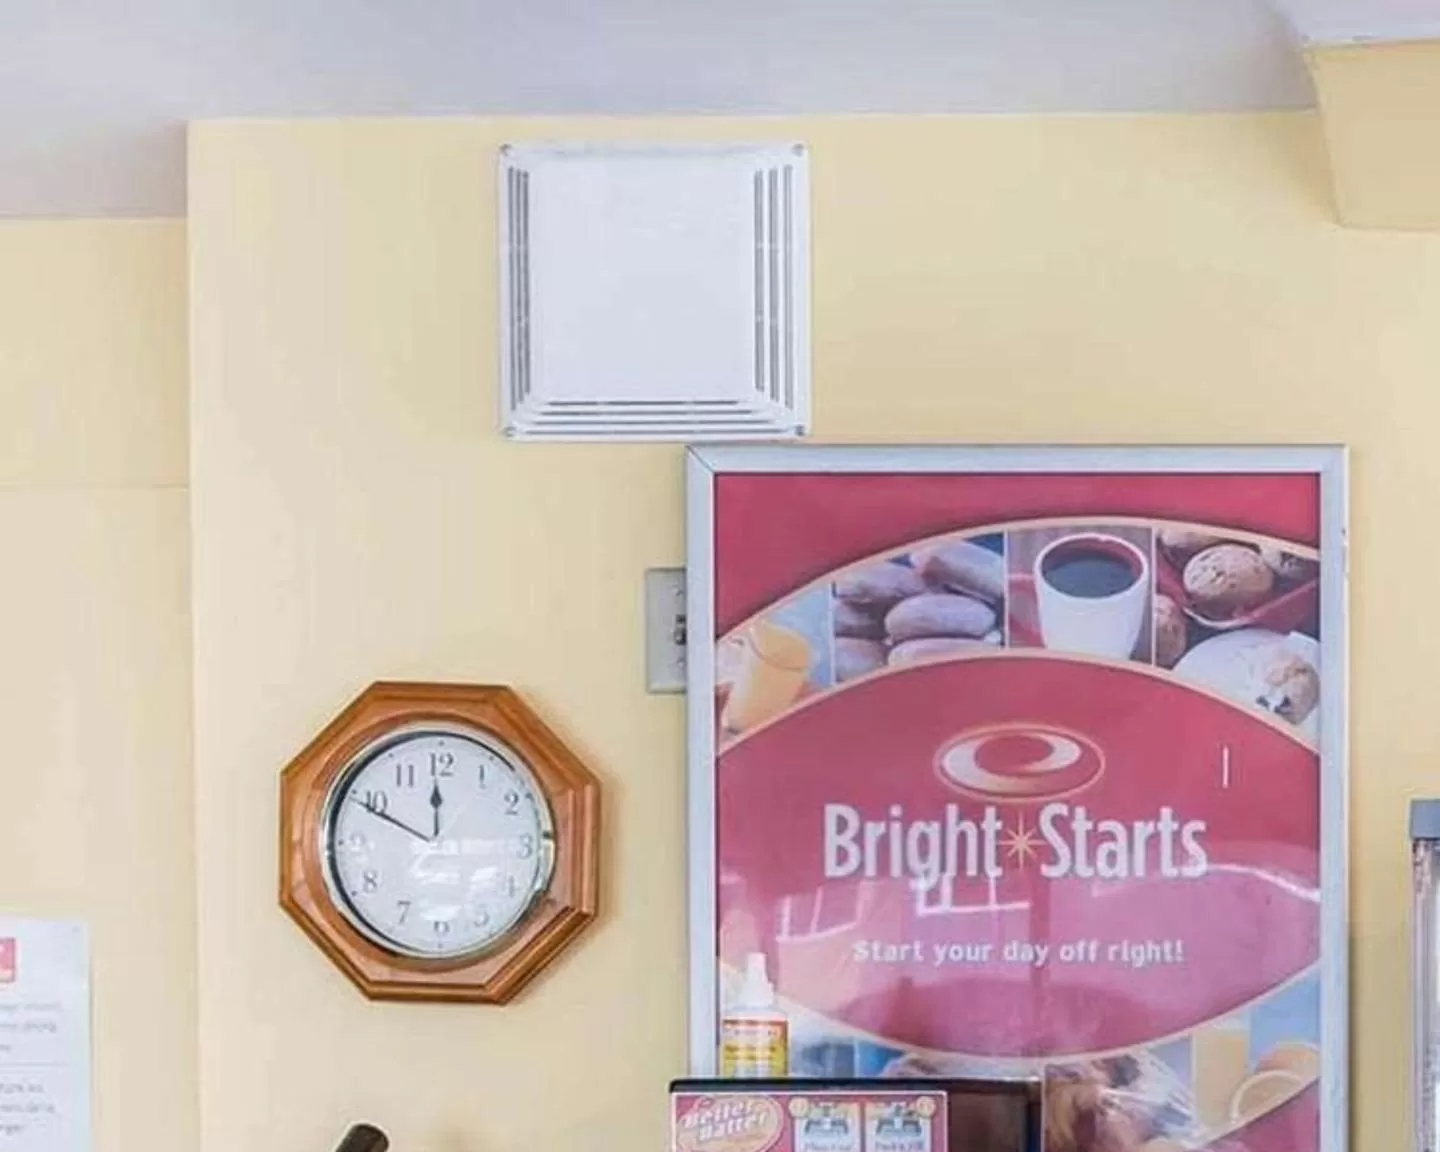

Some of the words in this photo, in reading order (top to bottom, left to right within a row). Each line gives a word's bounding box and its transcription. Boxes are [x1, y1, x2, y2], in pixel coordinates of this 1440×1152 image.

[395, 763, 415, 788] 11
[429, 752, 455, 777] 12
[477, 763, 488, 789] 1
[364, 790, 389, 814] 10
[504, 793, 520, 816] 2
[519, 834, 534, 860] 3
[823, 802, 1003, 892] Bright
[1039, 802, 1209, 879] Starts
[362, 869, 379, 887] 8
[397, 900, 412, 924] 7
[852, 939, 925, 963] Start
[933, 942, 994, 968] your
[1003, 939, 1048, 968] day
[1058, 939, 1099, 963] off
[1107, 939, 1184, 969] right!
